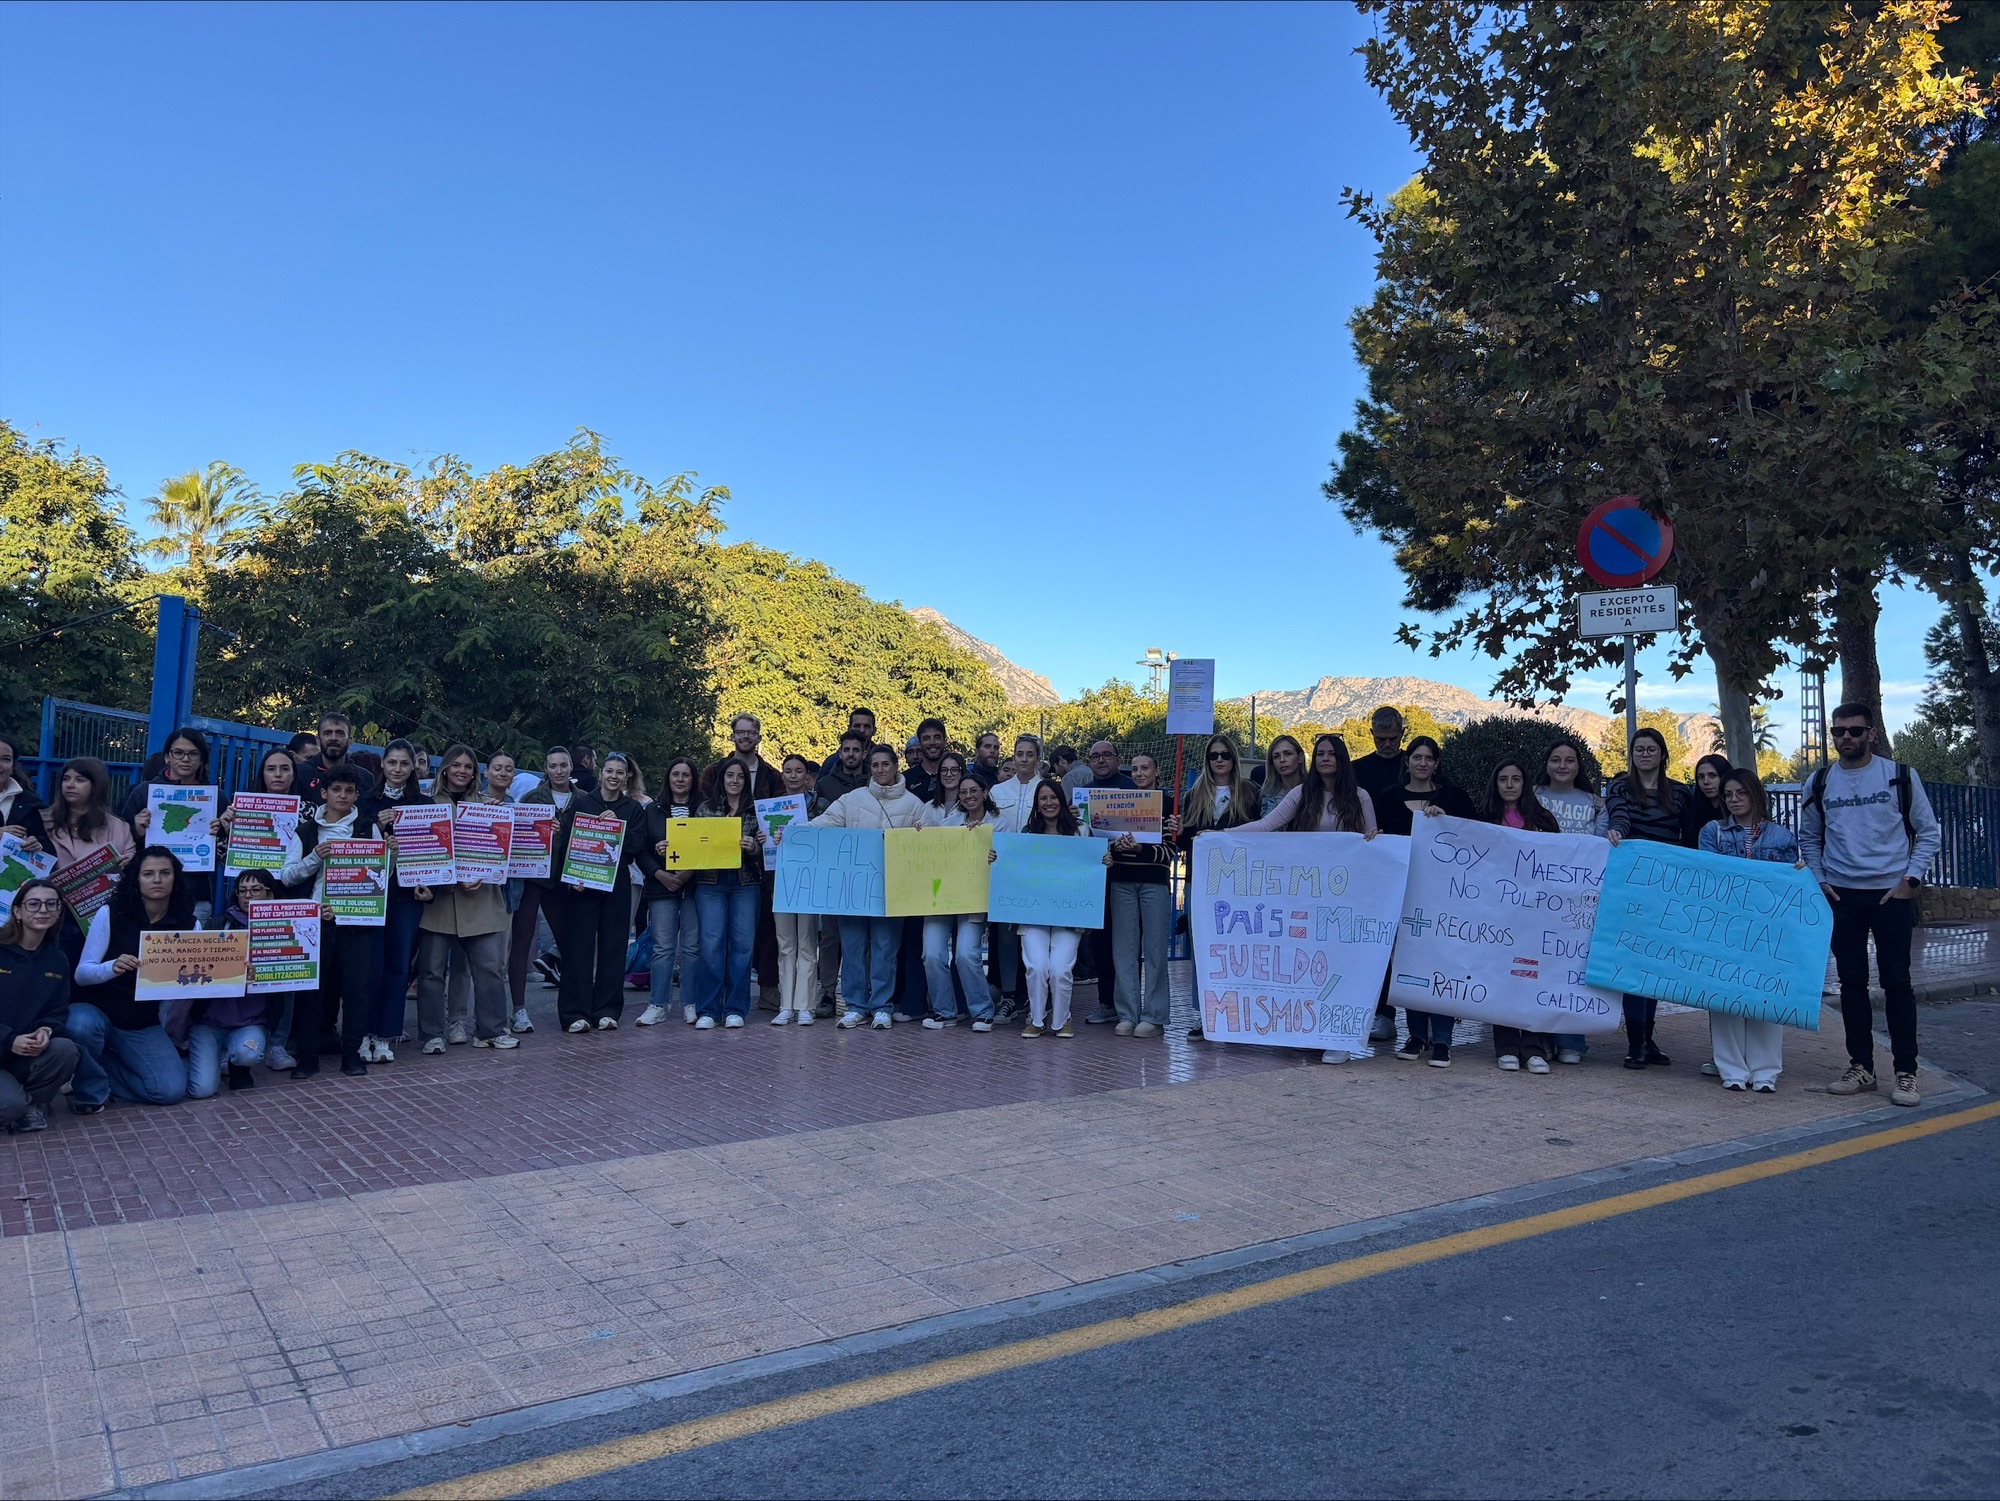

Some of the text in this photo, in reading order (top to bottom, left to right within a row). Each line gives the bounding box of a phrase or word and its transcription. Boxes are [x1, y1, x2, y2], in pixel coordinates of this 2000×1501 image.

[1590, 604, 1666, 617] RESIDENTES
[1600, 594, 1655, 606] EXCEPTO
[458, 805, 468, 819] 7
[1824, 793, 1877, 810] Timberland
[467, 811, 510, 820] MOBILITZACIÓ
[1560, 820, 1573, 828] OF
[1448, 872, 1563, 911] NO PULPO
[1625, 855, 1824, 926] EDUCADORES/AS
[998, 896, 1042, 909] ESCOLA
[1214, 900, 1284, 938] PAÍS
[1435, 911, 1515, 947] RECURSOS
[1626, 898, 1794, 965] DE ESPECIAL
[1611, 964, 1623, 982] Y
[1615, 930, 1790, 998] RECLASIFICACIÓN
[1204, 990, 1317, 1035] MISMOS
[1536, 991, 1610, 1016] CALIDAD
